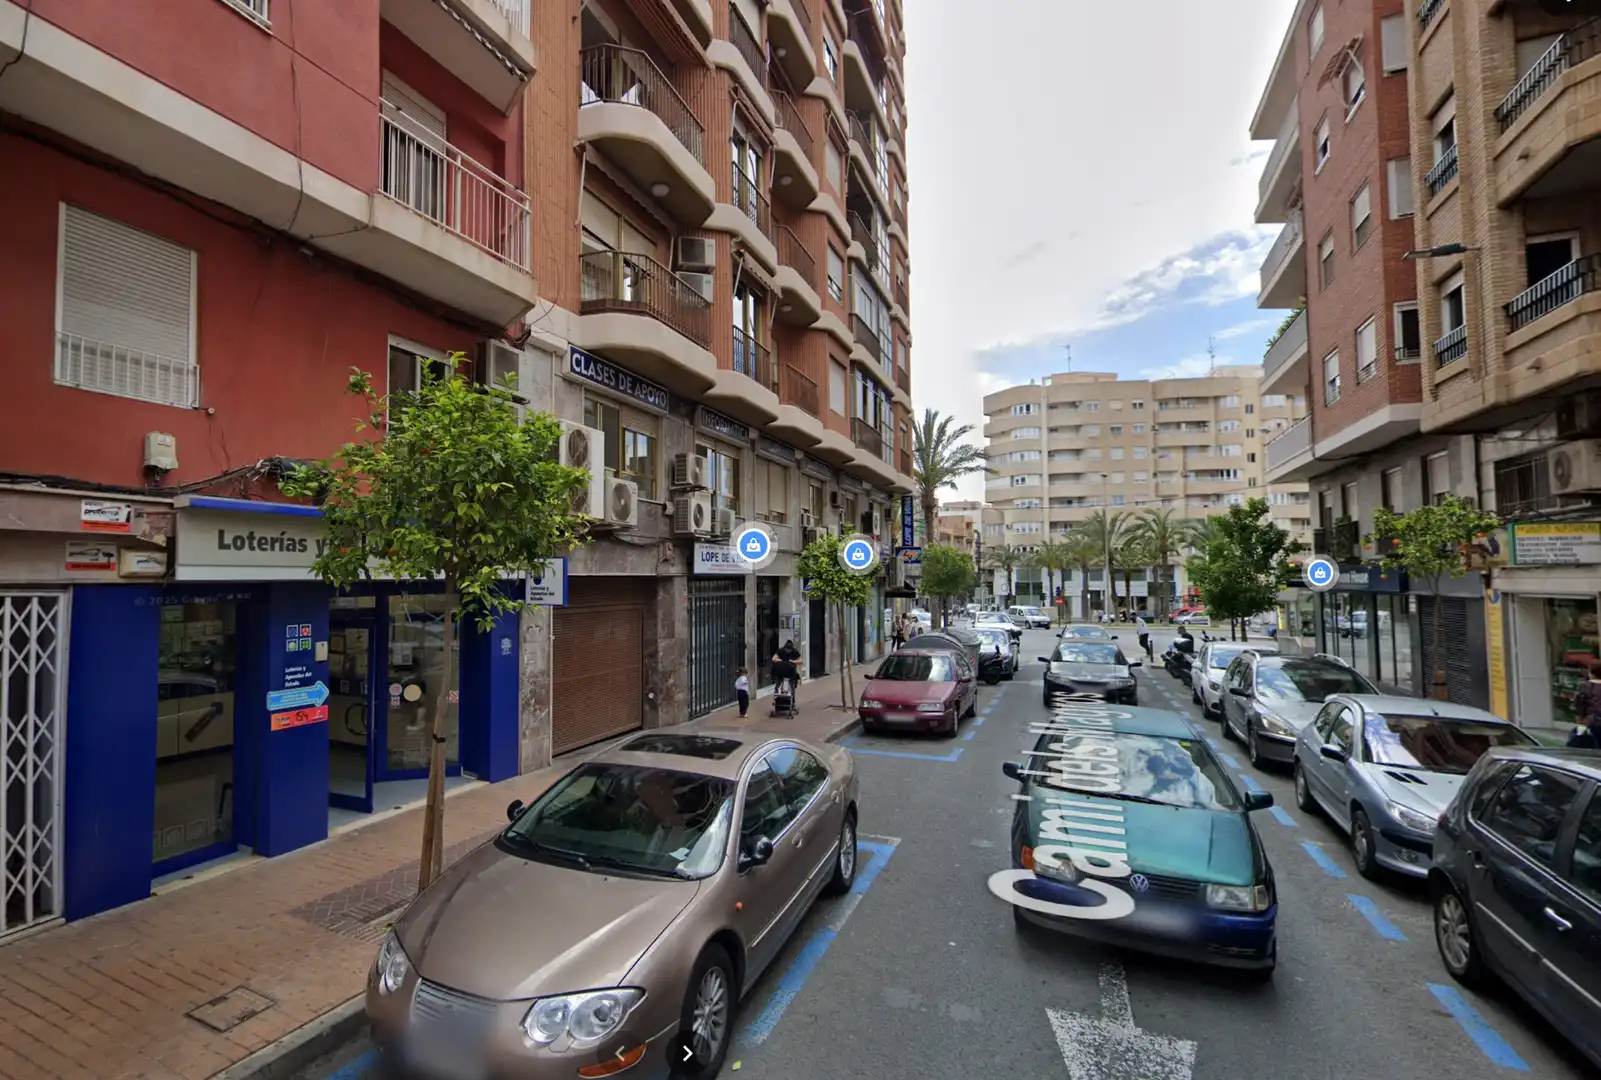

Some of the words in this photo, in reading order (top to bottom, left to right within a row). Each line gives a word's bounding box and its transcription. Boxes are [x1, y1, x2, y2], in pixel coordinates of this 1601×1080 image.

[572, 353, 616, 386] CLASES
[619, 373, 633, 393] DE
[634, 382, 667, 407] APOYO
[217, 528, 308, 553] Loterías
[315, 538, 328, 559] y
[904, 526, 912, 546] LOPE
[701, 551, 719, 563] LOPE
[721, 553, 730, 563] DE
